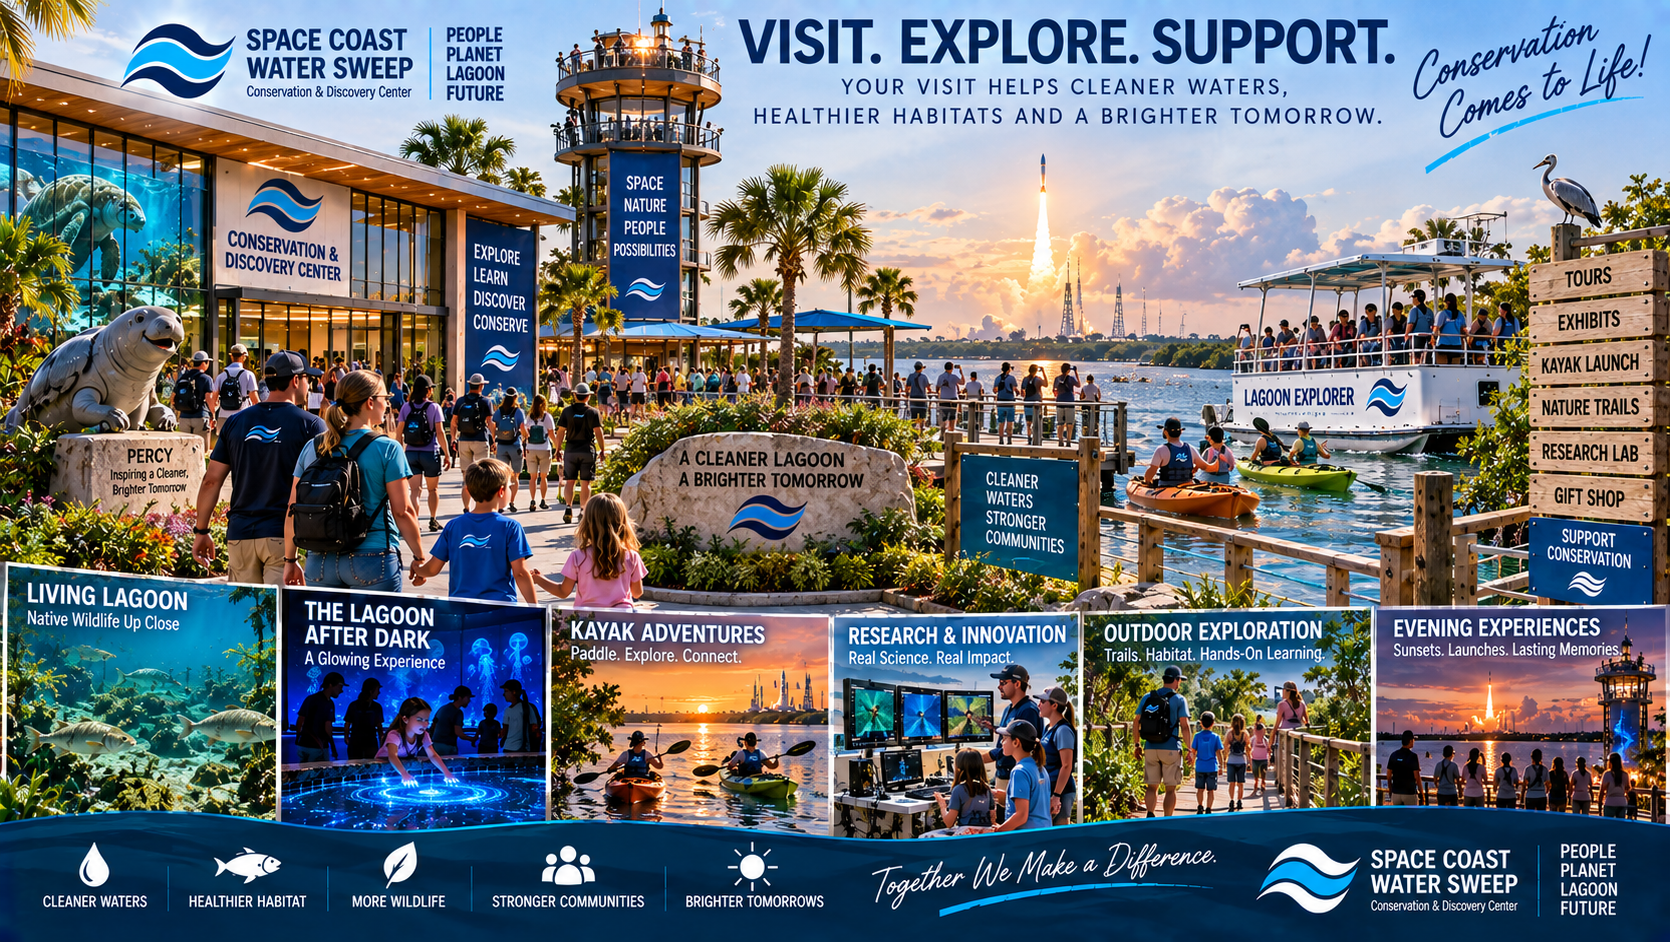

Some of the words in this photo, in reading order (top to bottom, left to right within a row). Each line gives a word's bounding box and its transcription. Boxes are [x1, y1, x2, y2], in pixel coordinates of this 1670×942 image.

[626, 175, 664, 191] SPACE
[624, 198, 667, 213] NATURE
[624, 221, 666, 235] PEOPLE
[227, 230, 326, 260] CONSERVATION
[328, 246, 339, 262] &
[474, 243, 520, 266] EXPLORE
[614, 243, 676, 257] POSSIBILITIES
[225, 250, 294, 278] DISCOVERY
[298, 258, 341, 281] CENTER
[474, 266, 508, 286] LEARN
[1565, 266, 1611, 288] TOURS
[474, 290, 525, 311] DISCOVER
[473, 314, 528, 333] CONSERVE
[1558, 310, 1620, 331] EXHIBITS
[1541, 356, 1582, 374] KAYAK
[1585, 353, 1639, 372] LAUNCH
[1244, 388, 1290, 406] LAGOON
[1295, 387, 1354, 406] EXPLORER
[1542, 399, 1590, 416] NATURE
[1594, 398, 1639, 415] TRAILS
[127, 447, 173, 464] PERCY
[679, 451, 691, 465] A
[695, 450, 768, 467] CLEANER
[774, 451, 845, 468] LAGOON
[1542, 443, 1608, 461] RESEARCH
[1613, 445, 1638, 462] LAB
[110, 469, 147, 482] Inspiring
[149, 471, 154, 479] a
[156, 467, 189, 480] Cleaner,
[679, 472, 690, 486] A
[694, 472, 766, 488] BRIGHTER
[771, 472, 864, 489] TOMORROW
[986, 471, 1039, 490] CLEANER
[112, 483, 146, 498] Brighter
[148, 482, 187, 494] Tomorrow
[1555, 487, 1583, 505] GIFT
[1587, 489, 1625, 507] SHOP
[986, 490, 1034, 510] WATERS
[986, 510, 1047, 532] STRONGER
[985, 530, 1065, 555] COMMUNITIES
[1562, 529, 1616, 548] SUPPORT
[1547, 546, 1631, 569] CONSERVATION
